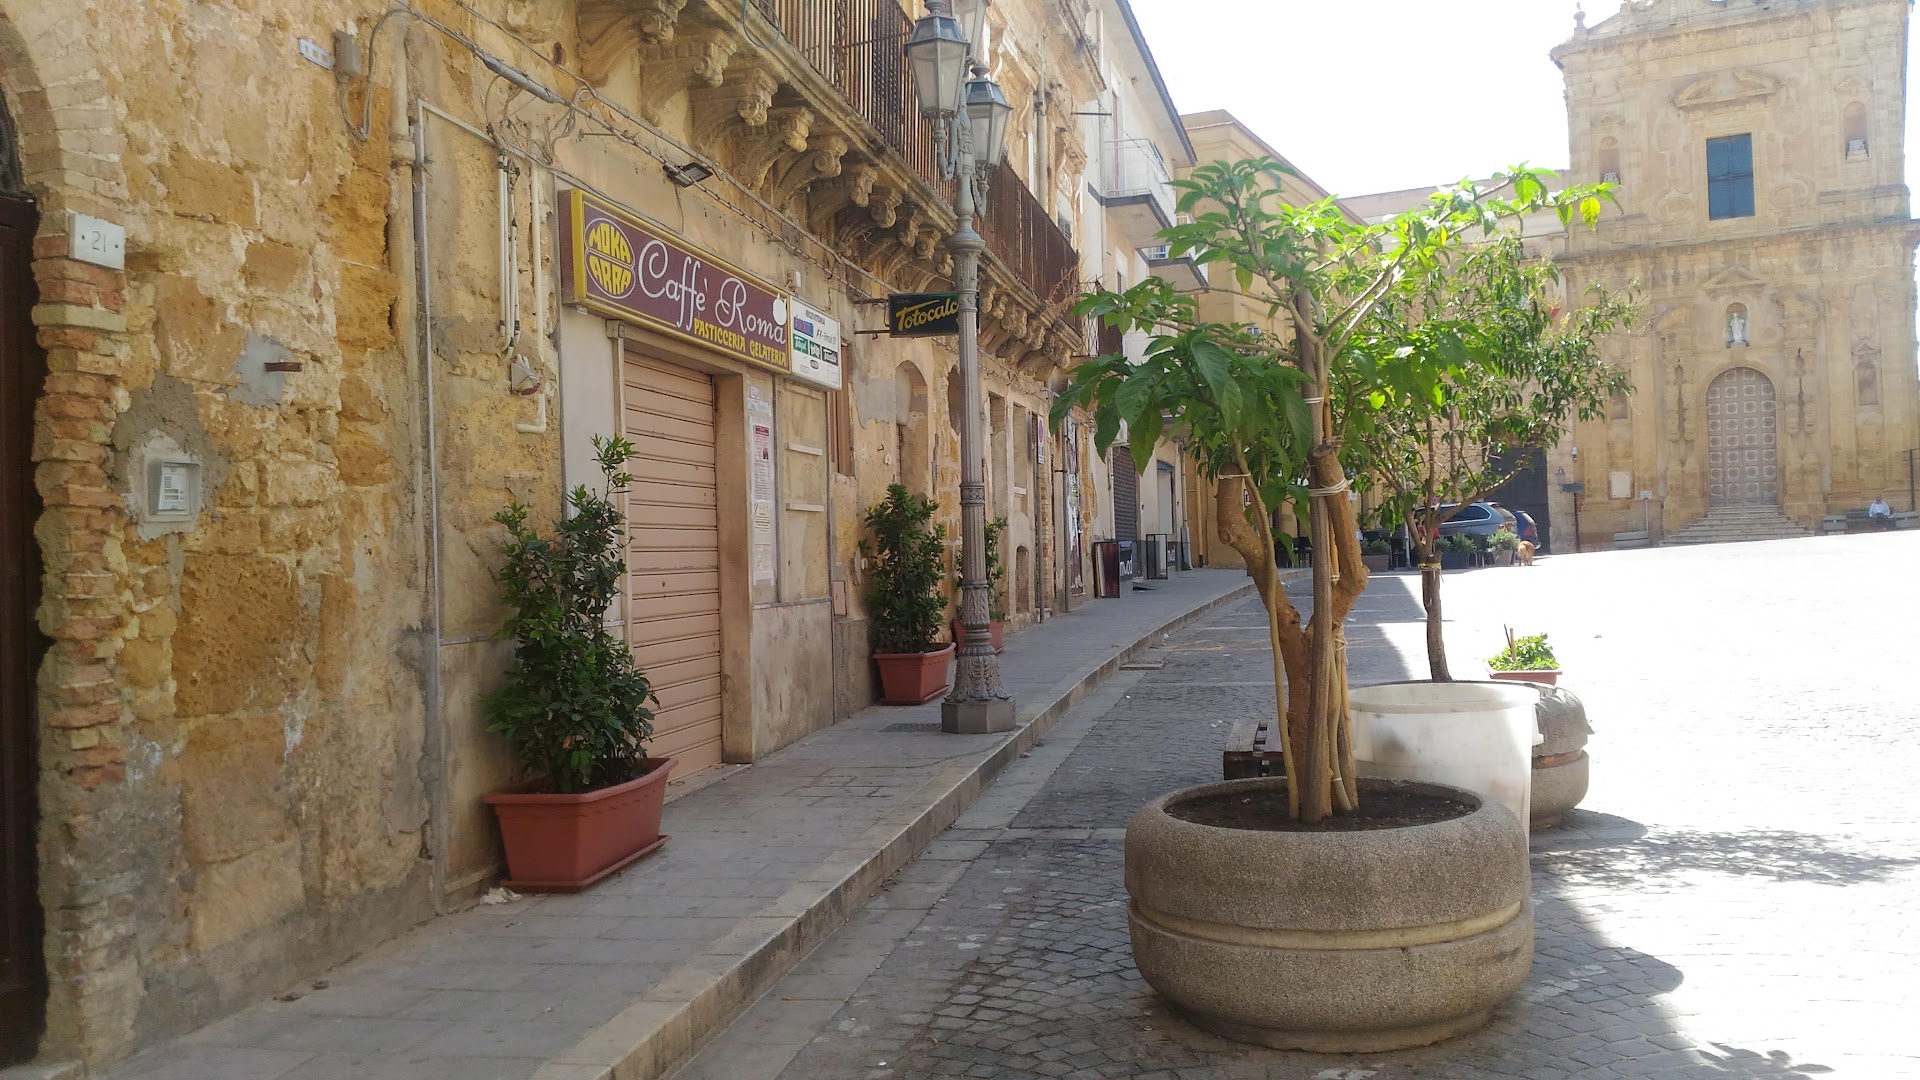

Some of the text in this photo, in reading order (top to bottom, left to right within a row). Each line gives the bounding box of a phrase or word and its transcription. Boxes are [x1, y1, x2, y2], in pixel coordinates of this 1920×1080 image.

[92, 230, 106, 253] 21
[588, 222, 632, 264] MOKA
[589, 254, 632, 295] ARRA
[638, 239, 787, 345] Caffè Roma
[895, 298, 960, 332] Totocalc
[693, 317, 746, 352] PASTICCERIA
[749, 340, 787, 366] GELATERIA
